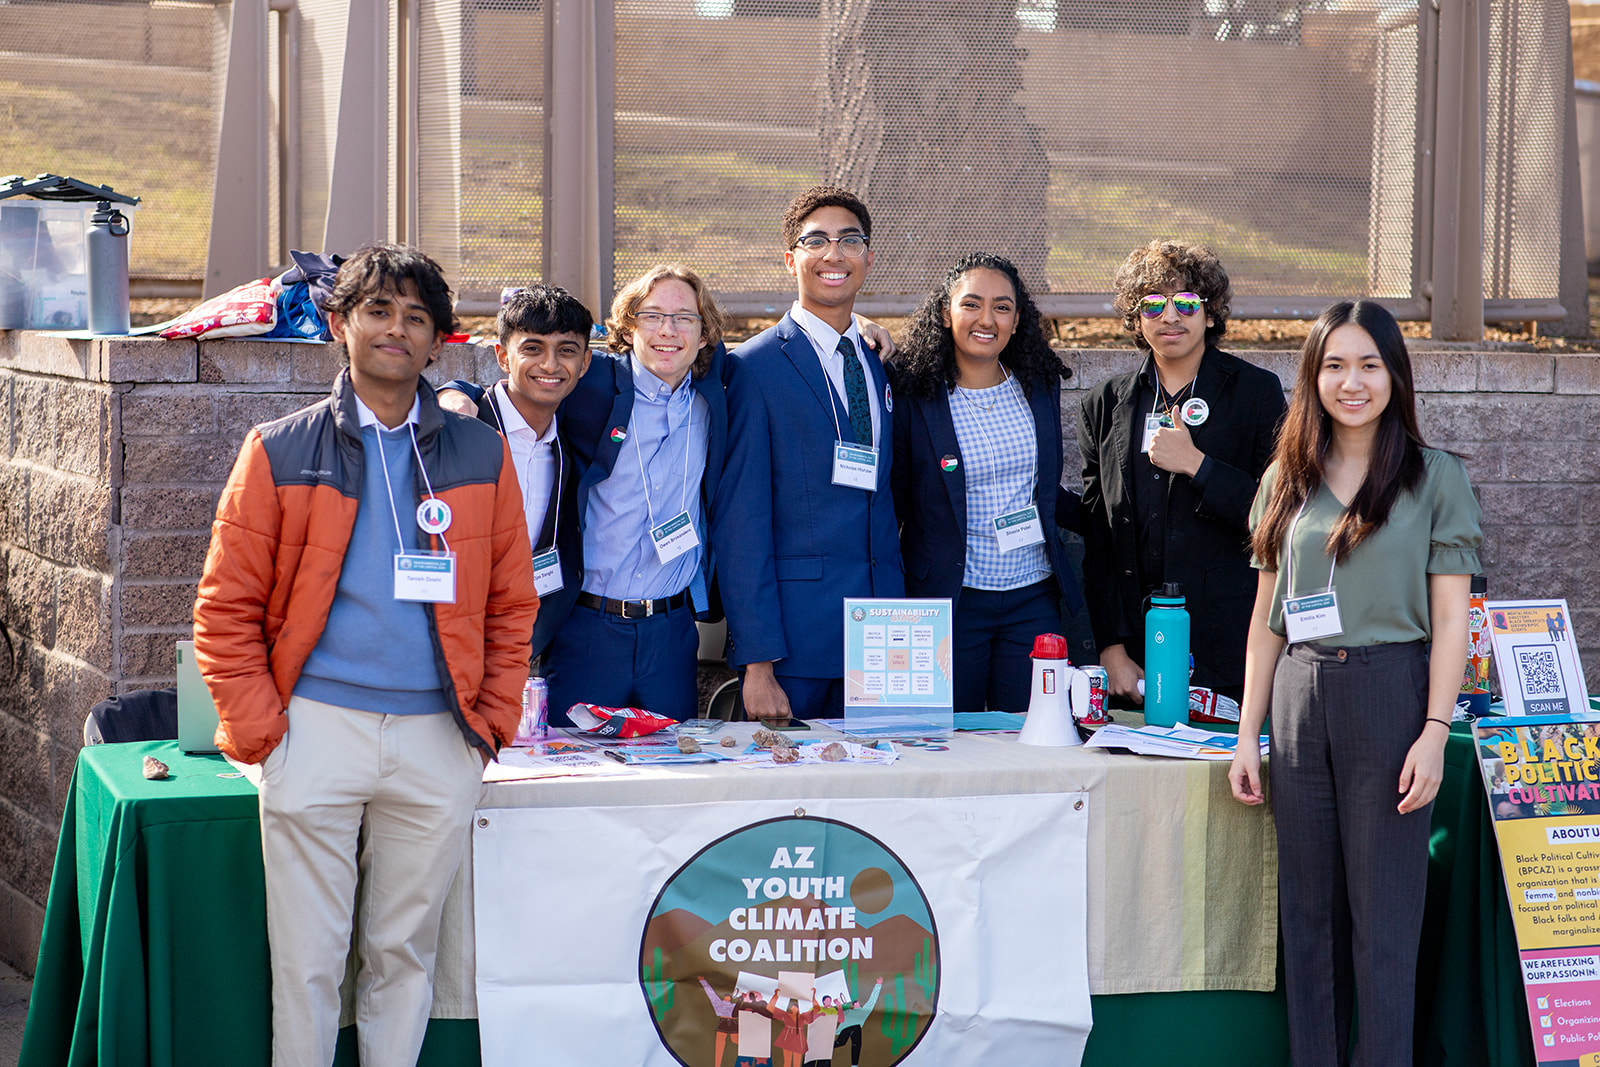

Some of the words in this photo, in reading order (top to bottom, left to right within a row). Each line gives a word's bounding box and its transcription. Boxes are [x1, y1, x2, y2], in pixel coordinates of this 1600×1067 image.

[660, 541, 670, 549] Owen
[870, 609, 940, 617] SUSTAINABILITY
[891, 615, 922, 624] BINGO
[1530, 703, 1551, 712] SCAN
[1552, 702, 1564, 711] ME
[1499, 737, 1600, 764] BLACK
[1508, 783, 1600, 804] CULTIVAT
[1552, 828, 1590, 839] ABOUT
[770, 846, 816, 869] AZ
[1516, 854, 1539, 863] Black
[1541, 852, 1574, 860] Political
[1518, 865, 1555, 876] (BPCAZ)
[742, 876, 845, 900] YOUTH
[1517, 879, 1569, 889] organization
[1525, 891, 1556, 899] femme,
[1558, 889, 1574, 898] and
[1518, 903, 1550, 912] focused
[1565, 900, 1598, 911] political
[728, 906, 856, 930] CLIMATE
[1533, 915, 1555, 924] Black
[1557, 914, 1577, 922] folks
[1580, 912, 1596, 921] and
[709, 937, 873, 962] COALITION
[1525, 961, 1539, 969] WE
[1540, 959, 1557, 968] ARE
[1558, 957, 1594, 967] FLEXING
[1526, 971, 1546, 980] OUR
[1546, 969, 1585, 979] PASSION
[1586, 968, 1598, 976] IN:
[1554, 998, 1591, 1008] Elections
[1560, 1033, 1586, 1043] Public
